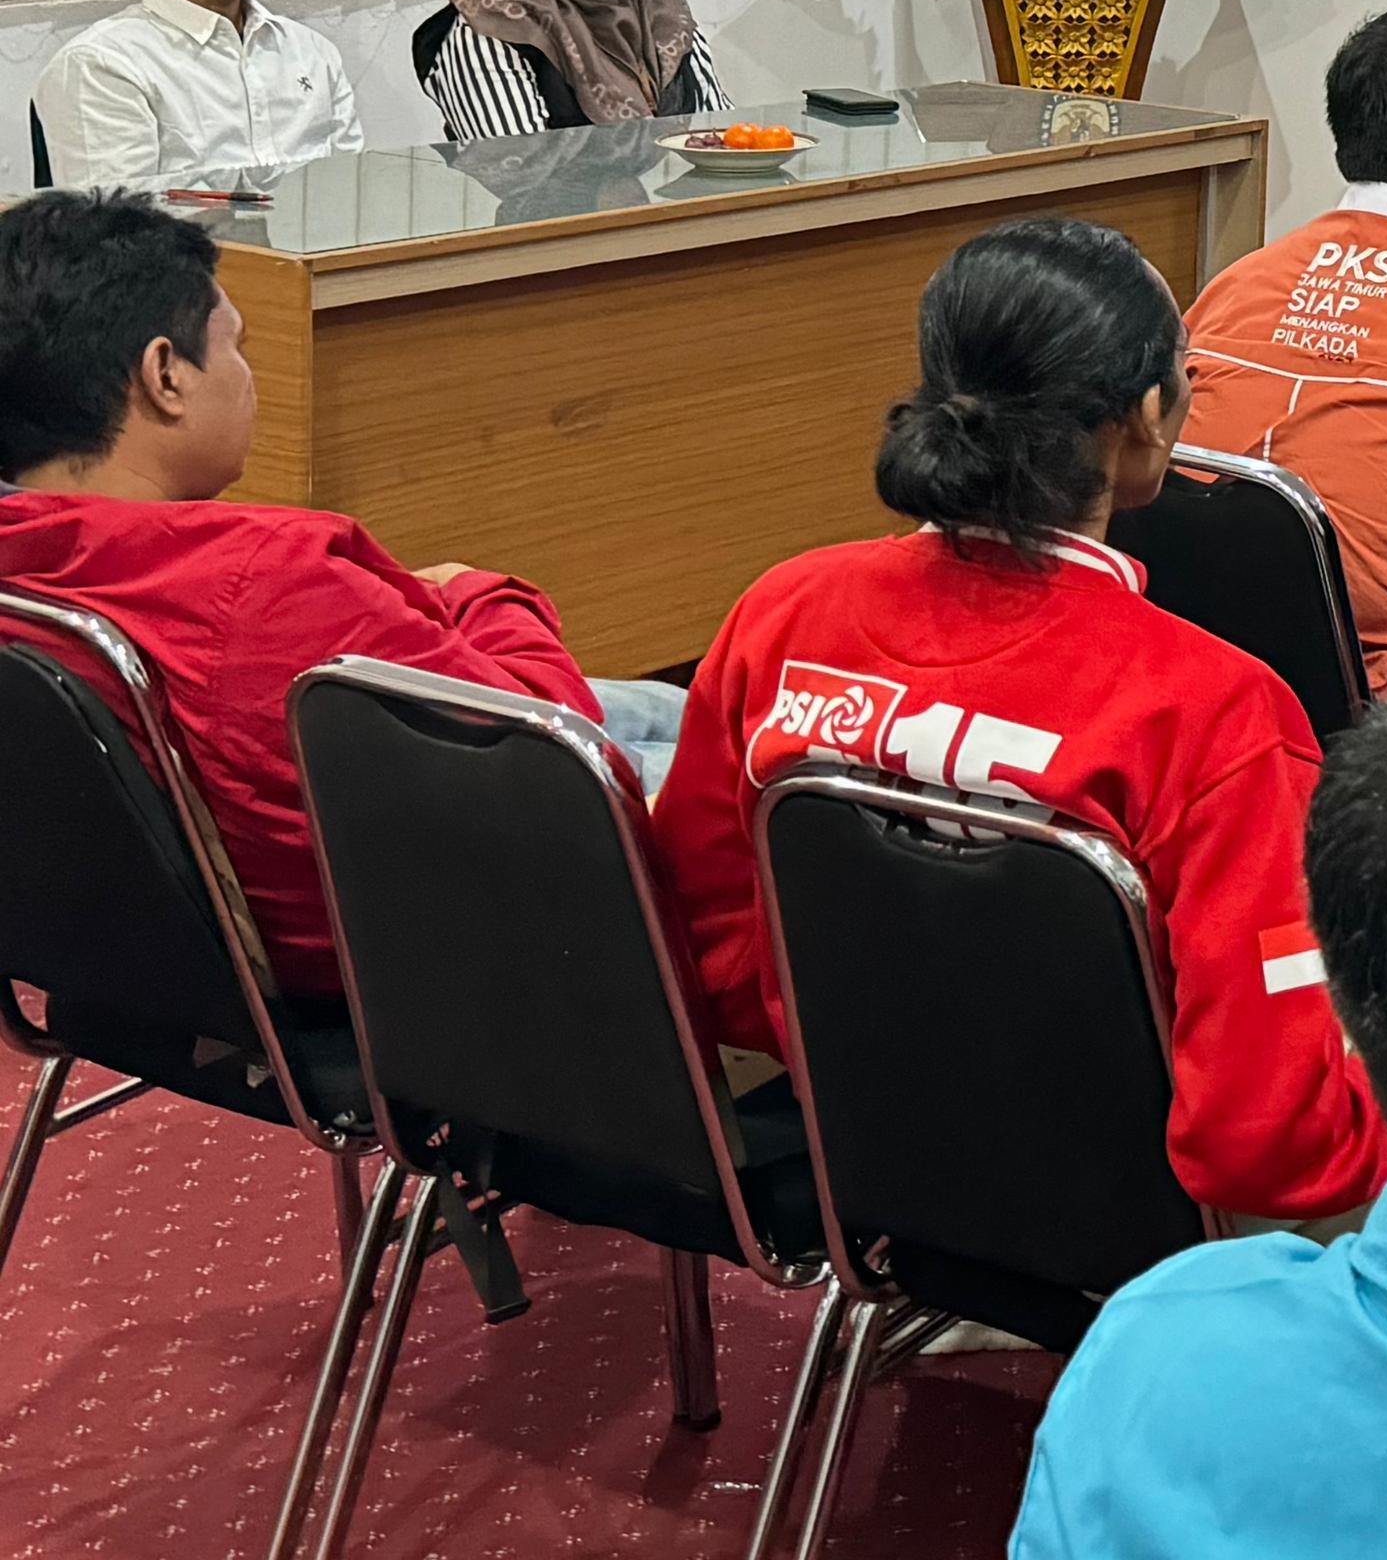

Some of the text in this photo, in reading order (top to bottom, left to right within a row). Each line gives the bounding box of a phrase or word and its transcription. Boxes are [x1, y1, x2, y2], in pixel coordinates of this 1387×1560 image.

[1297, 273, 1341, 291] JAWA
[1287, 288, 1361, 318] SIAP
[1280, 314, 1371, 338] MENANGKAN
[1271, 328, 1359, 358] PILKADA
[764, 688, 827, 737] PSI
